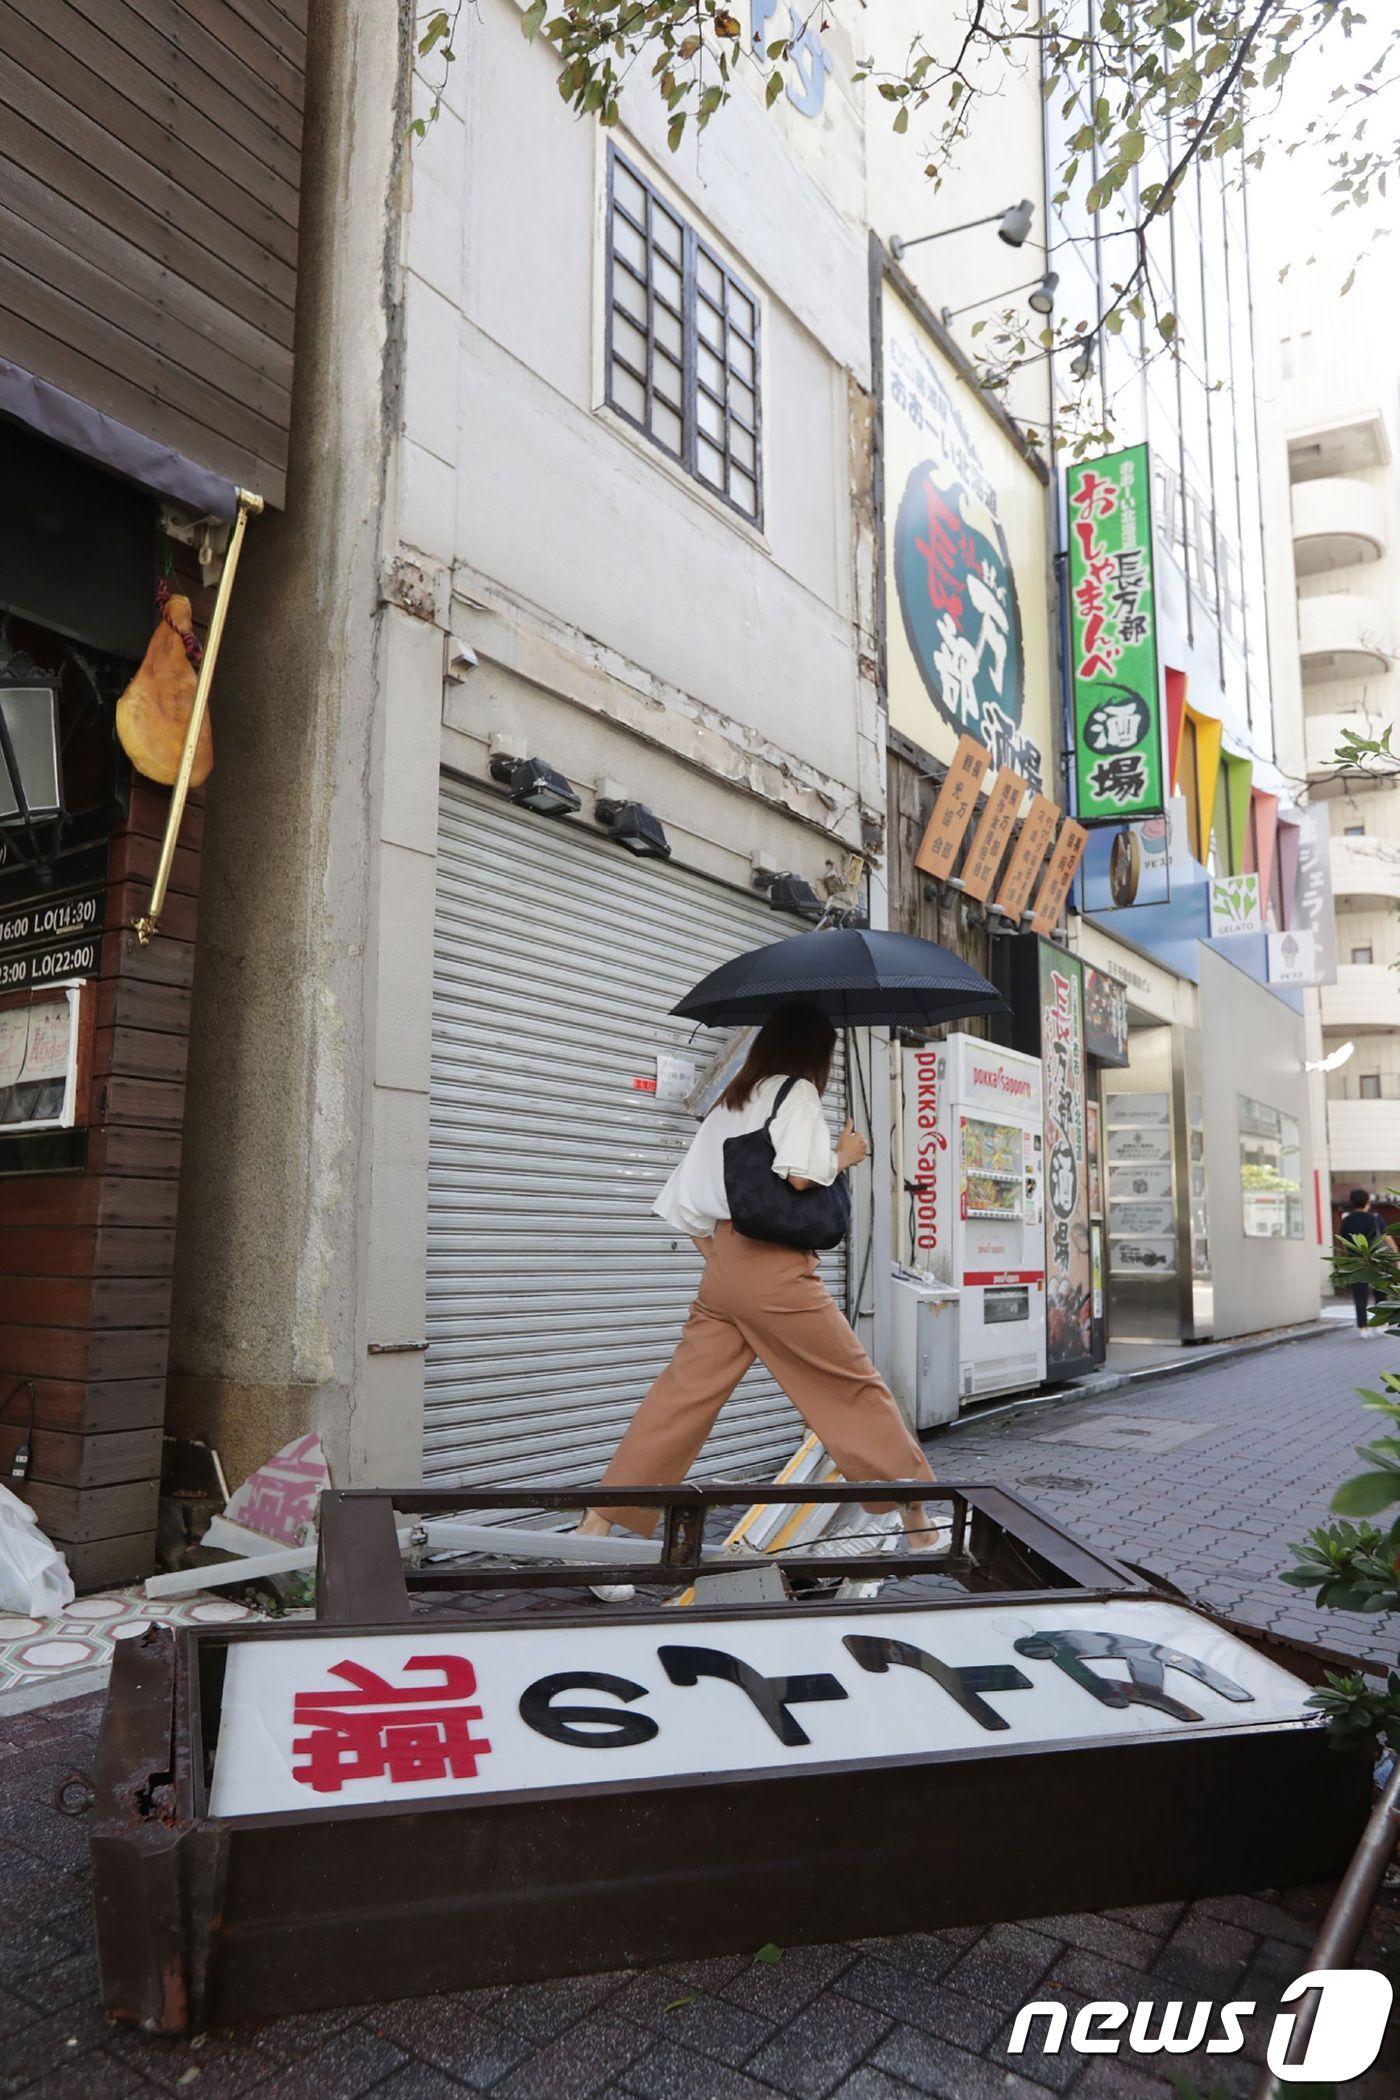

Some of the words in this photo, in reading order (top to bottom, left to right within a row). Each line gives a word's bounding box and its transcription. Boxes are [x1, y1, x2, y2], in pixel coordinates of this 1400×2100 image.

[1073, 473, 1120, 677] おしゃまんべ
[1111, 549, 1148, 643] 長万部
[1089, 701, 1146, 802] 酒場
[0, 917, 29, 940] 16:00
[34, 898, 96, 933] L.O(14:30)
[1218, 922, 1254, 934] GELATO
[0, 961, 26, 984] 3:00
[32, 945, 94, 977] L.O(22:00)
